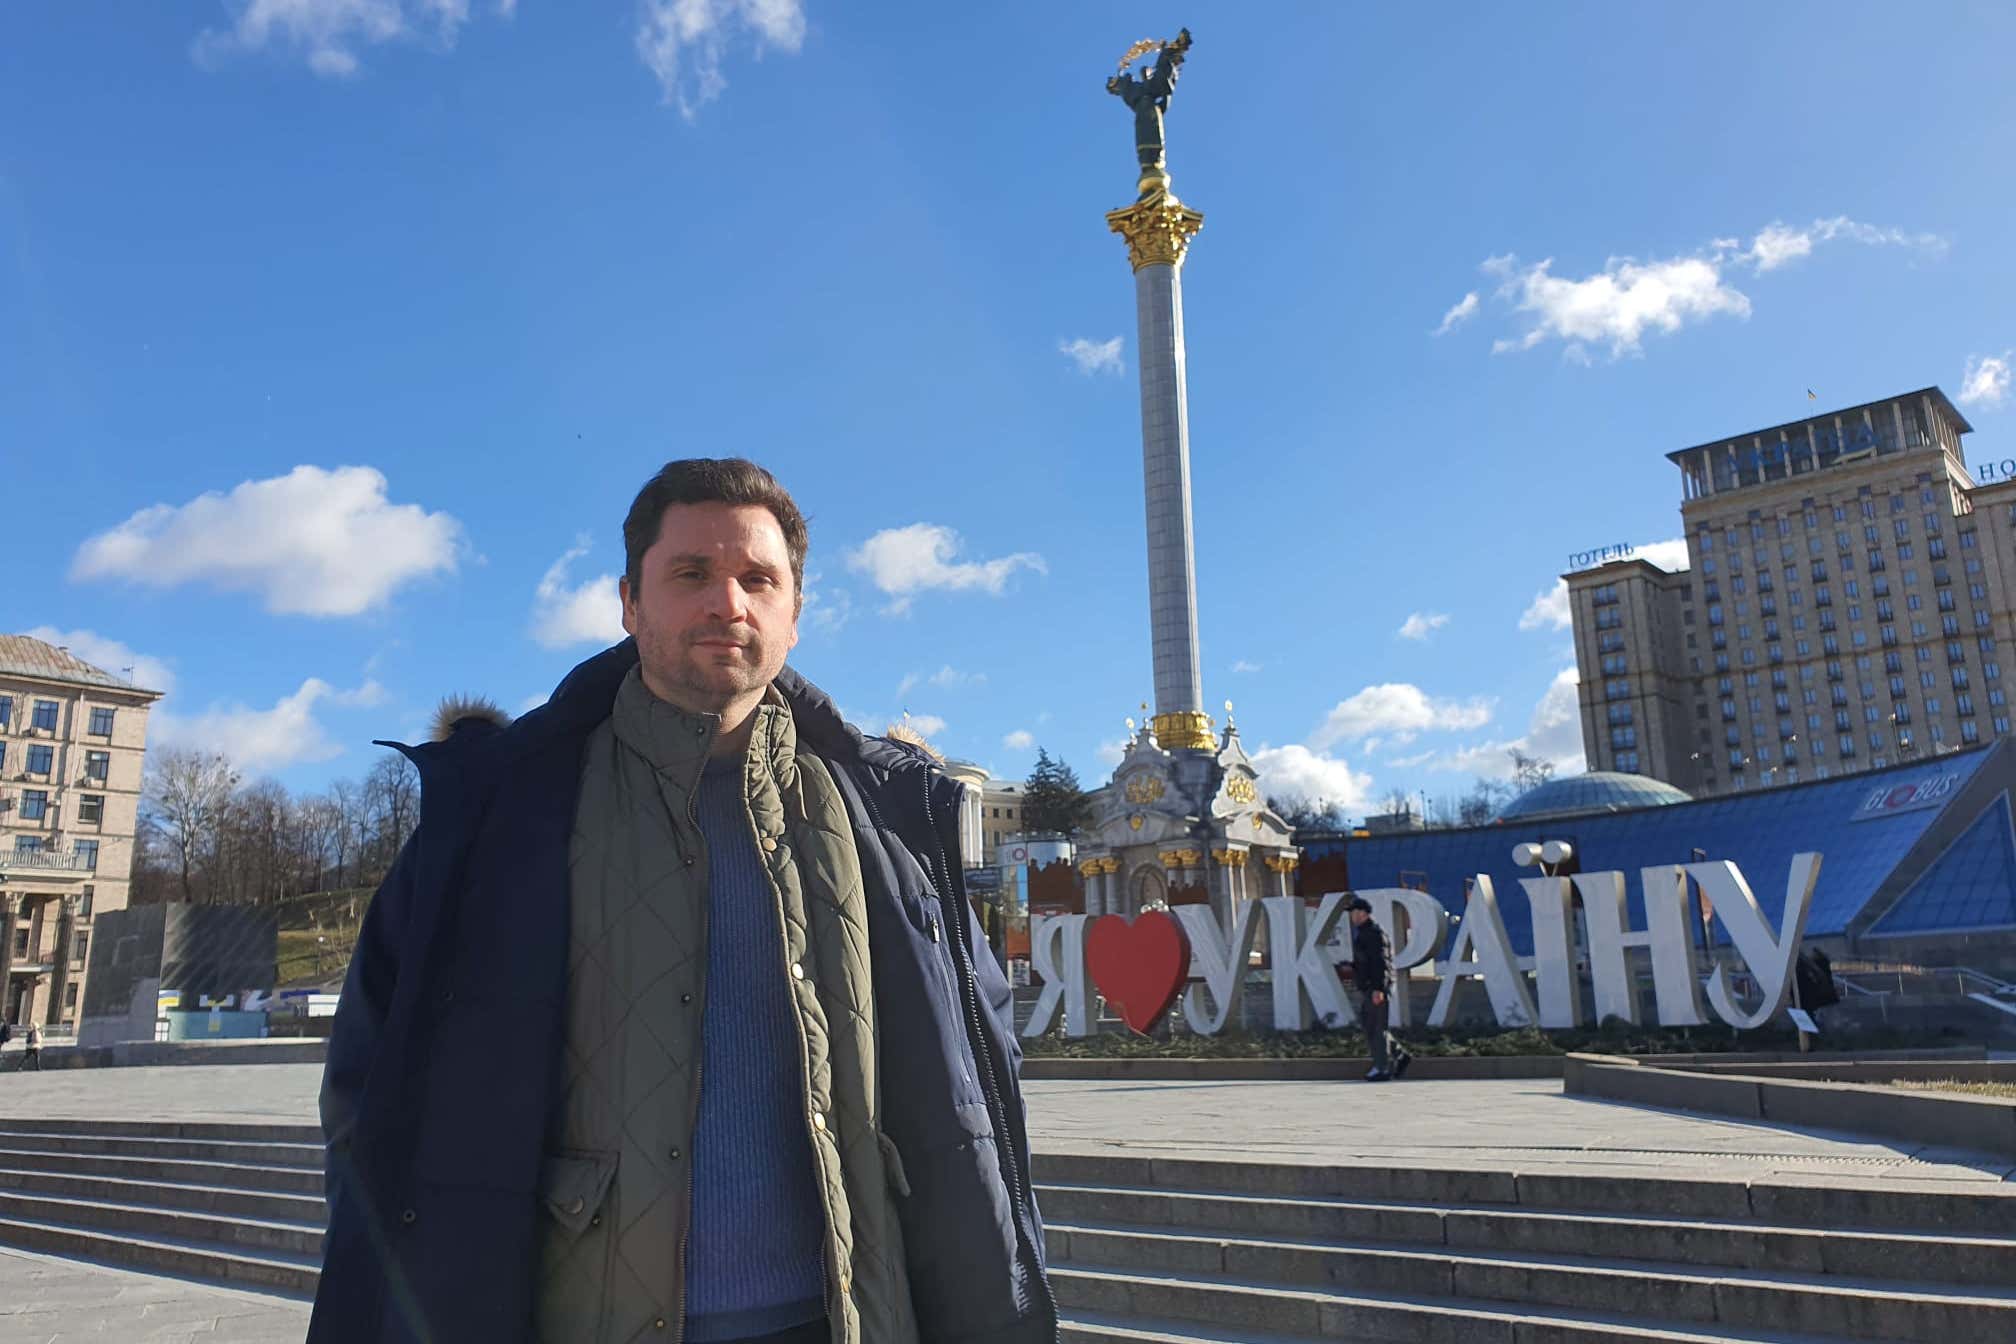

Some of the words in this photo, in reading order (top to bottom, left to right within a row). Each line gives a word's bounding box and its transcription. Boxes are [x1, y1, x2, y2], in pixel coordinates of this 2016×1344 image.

[1568, 542, 1634, 568] ГОТЕЛЬ
[1863, 774, 1960, 811] GLOBUS
[1021, 911, 1093, 1038] Я
[1170, 840, 1820, 1036] УКРАЇНУ
